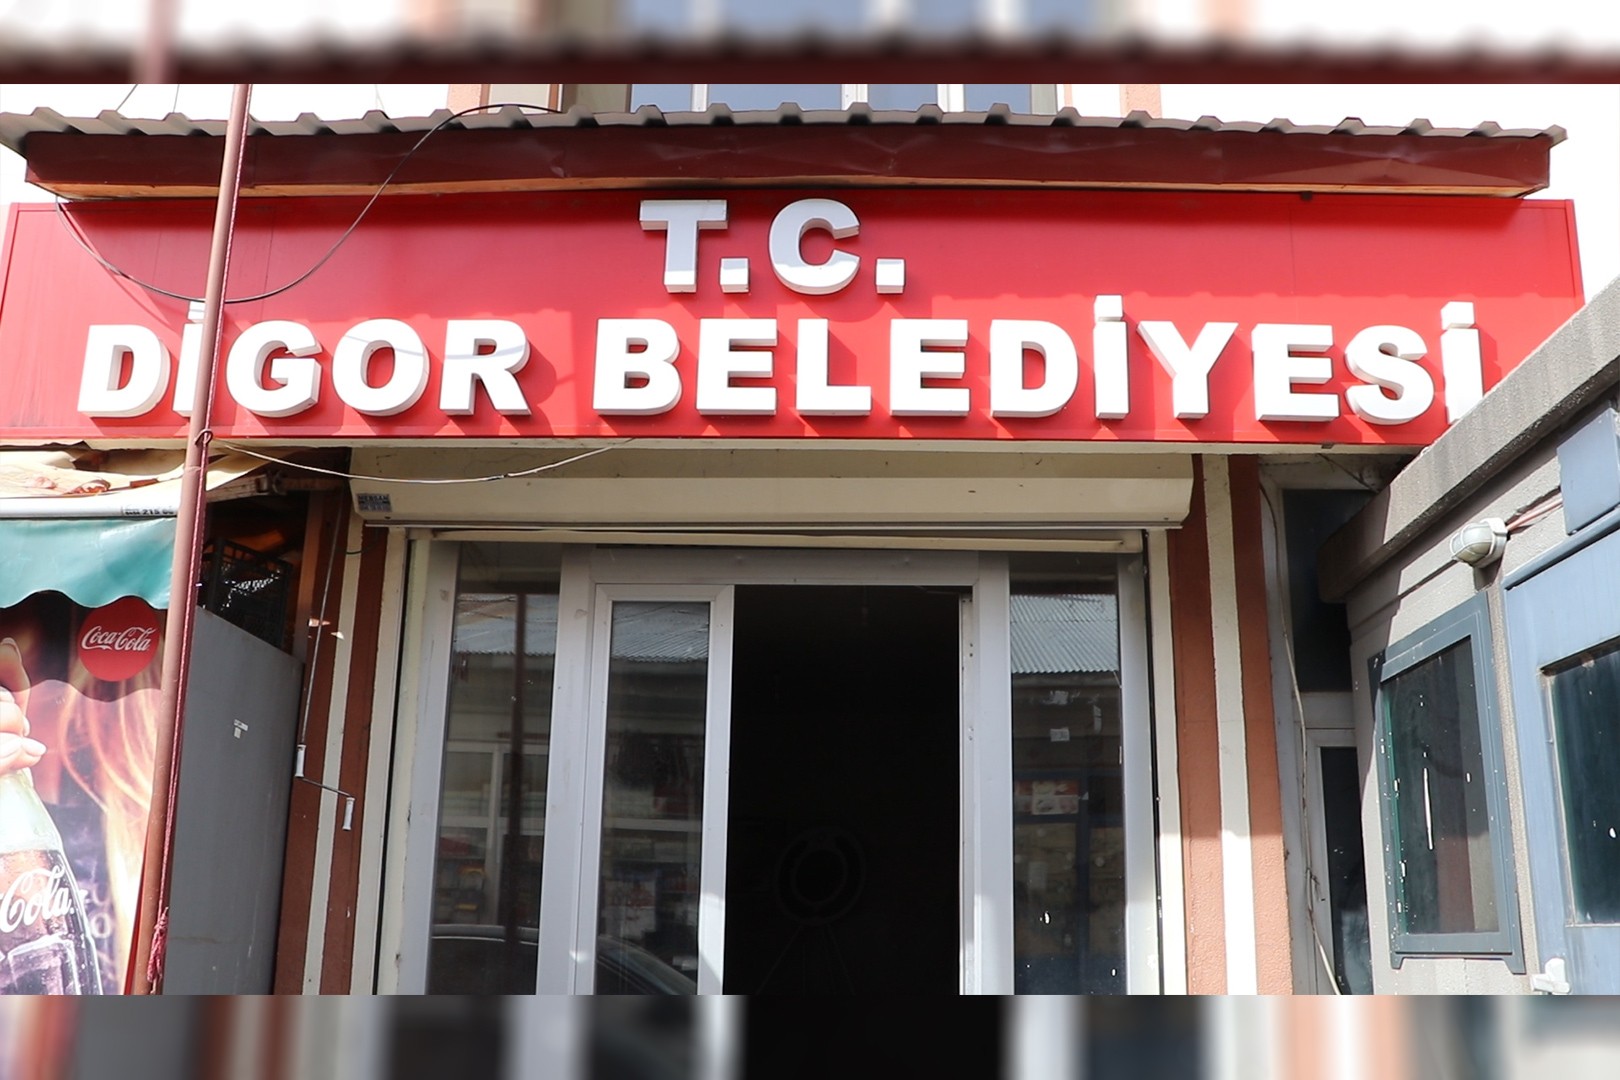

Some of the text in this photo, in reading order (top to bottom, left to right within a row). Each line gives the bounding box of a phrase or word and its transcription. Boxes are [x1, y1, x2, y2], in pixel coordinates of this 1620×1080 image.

[639, 198, 907, 296] T.C.
[77, 294, 1484, 426] DİGOR BELEDİYESİ
[81, 625, 157, 651] Coca-Cola
